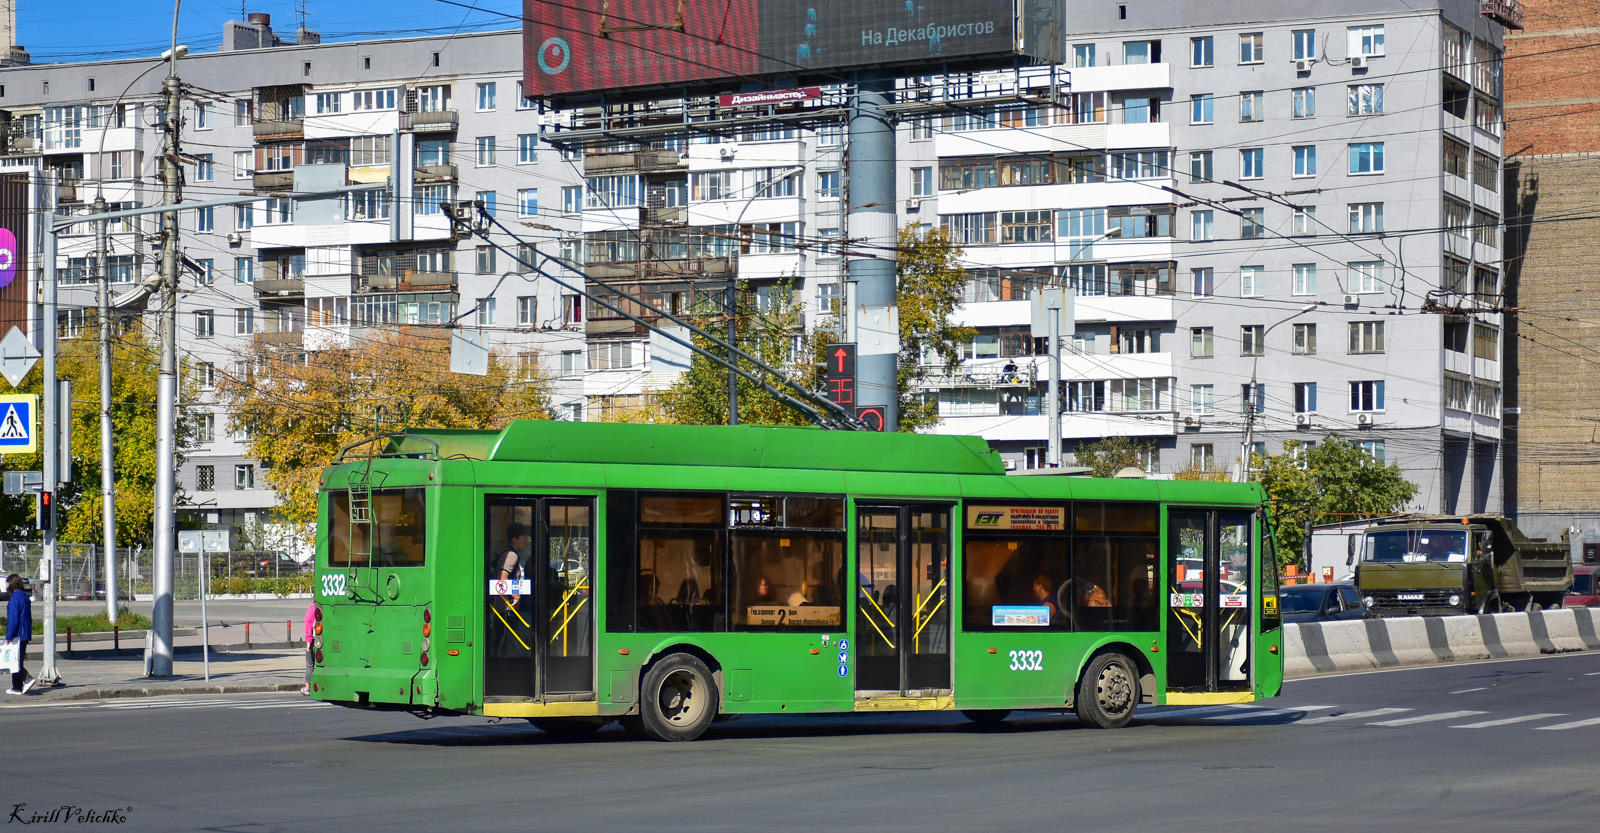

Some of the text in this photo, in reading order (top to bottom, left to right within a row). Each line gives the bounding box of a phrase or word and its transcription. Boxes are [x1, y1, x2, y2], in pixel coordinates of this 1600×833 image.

[861, 21, 995, 46] На Декабристов
[731, 91, 807, 105] Дизайнмастер
[829, 378, 853, 404] 35
[321, 574, 346, 597] 3332
[777, 608, 786, 626] 2
[1008, 649, 1043, 671] 3332
